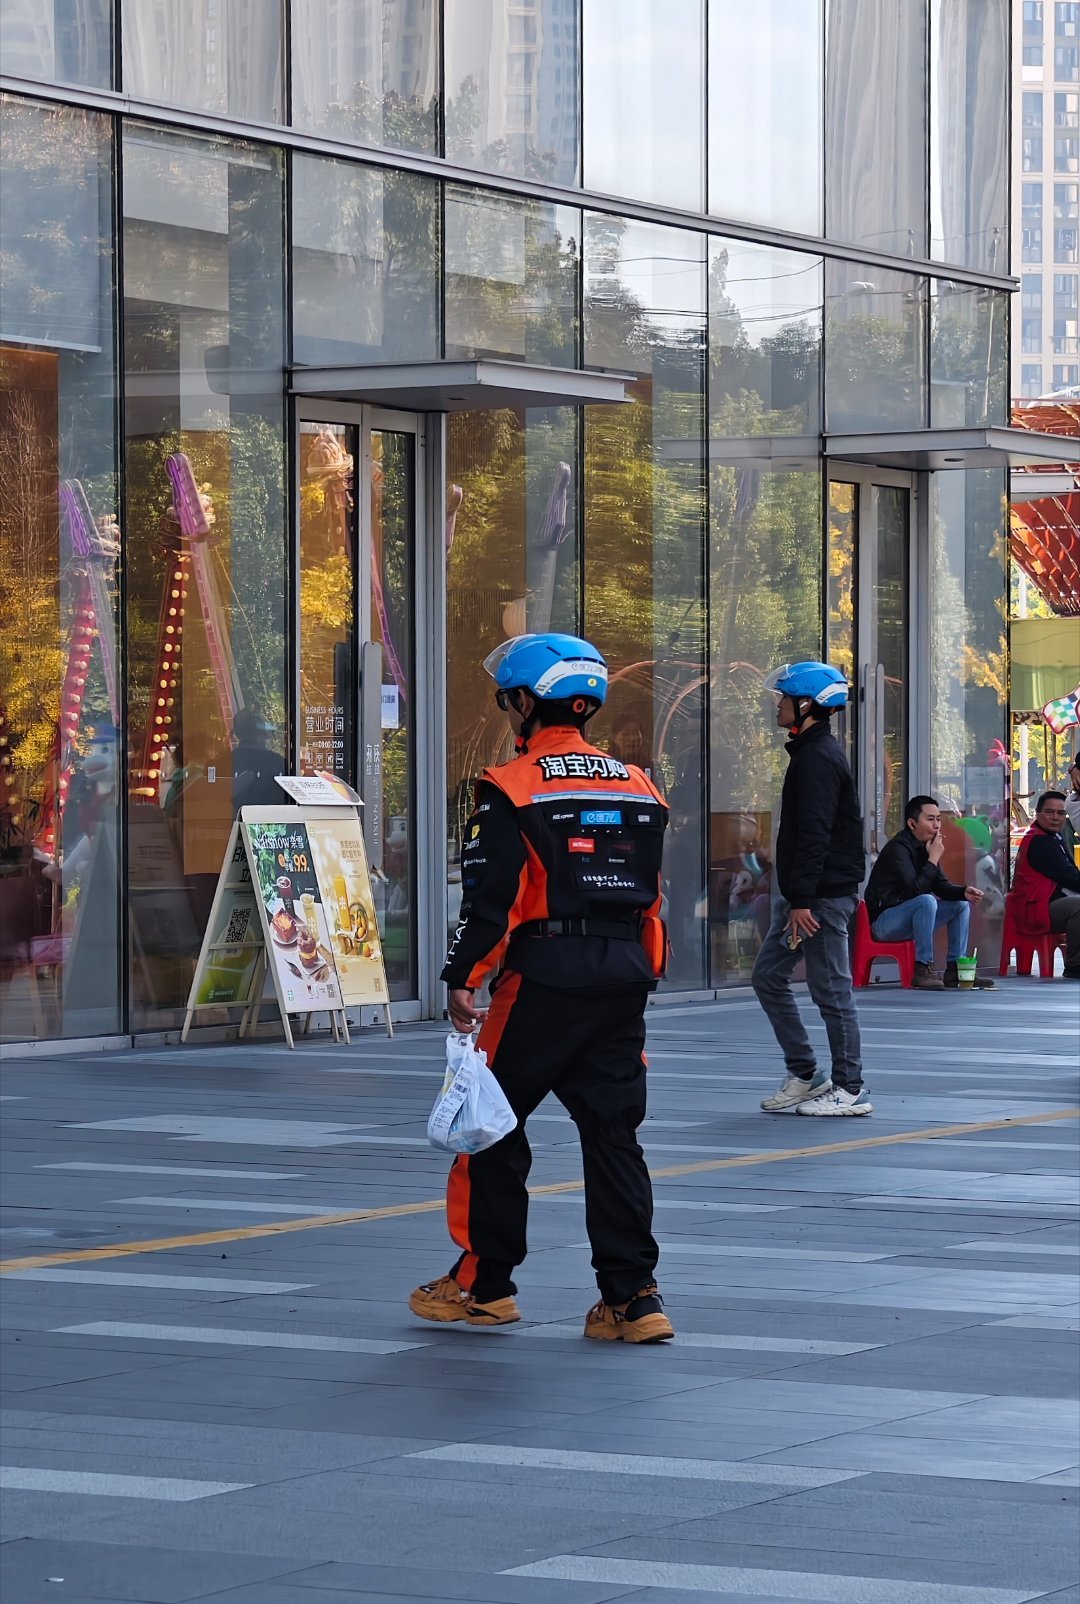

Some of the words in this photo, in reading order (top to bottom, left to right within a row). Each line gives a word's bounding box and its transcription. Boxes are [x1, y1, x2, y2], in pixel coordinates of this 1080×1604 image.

[305, 705, 326, 714] BUSINESS
[328, 705, 344, 714] HOURS
[305, 715, 344, 734] 营业时间
[540, 754, 629, 778] 淘宝闪购
